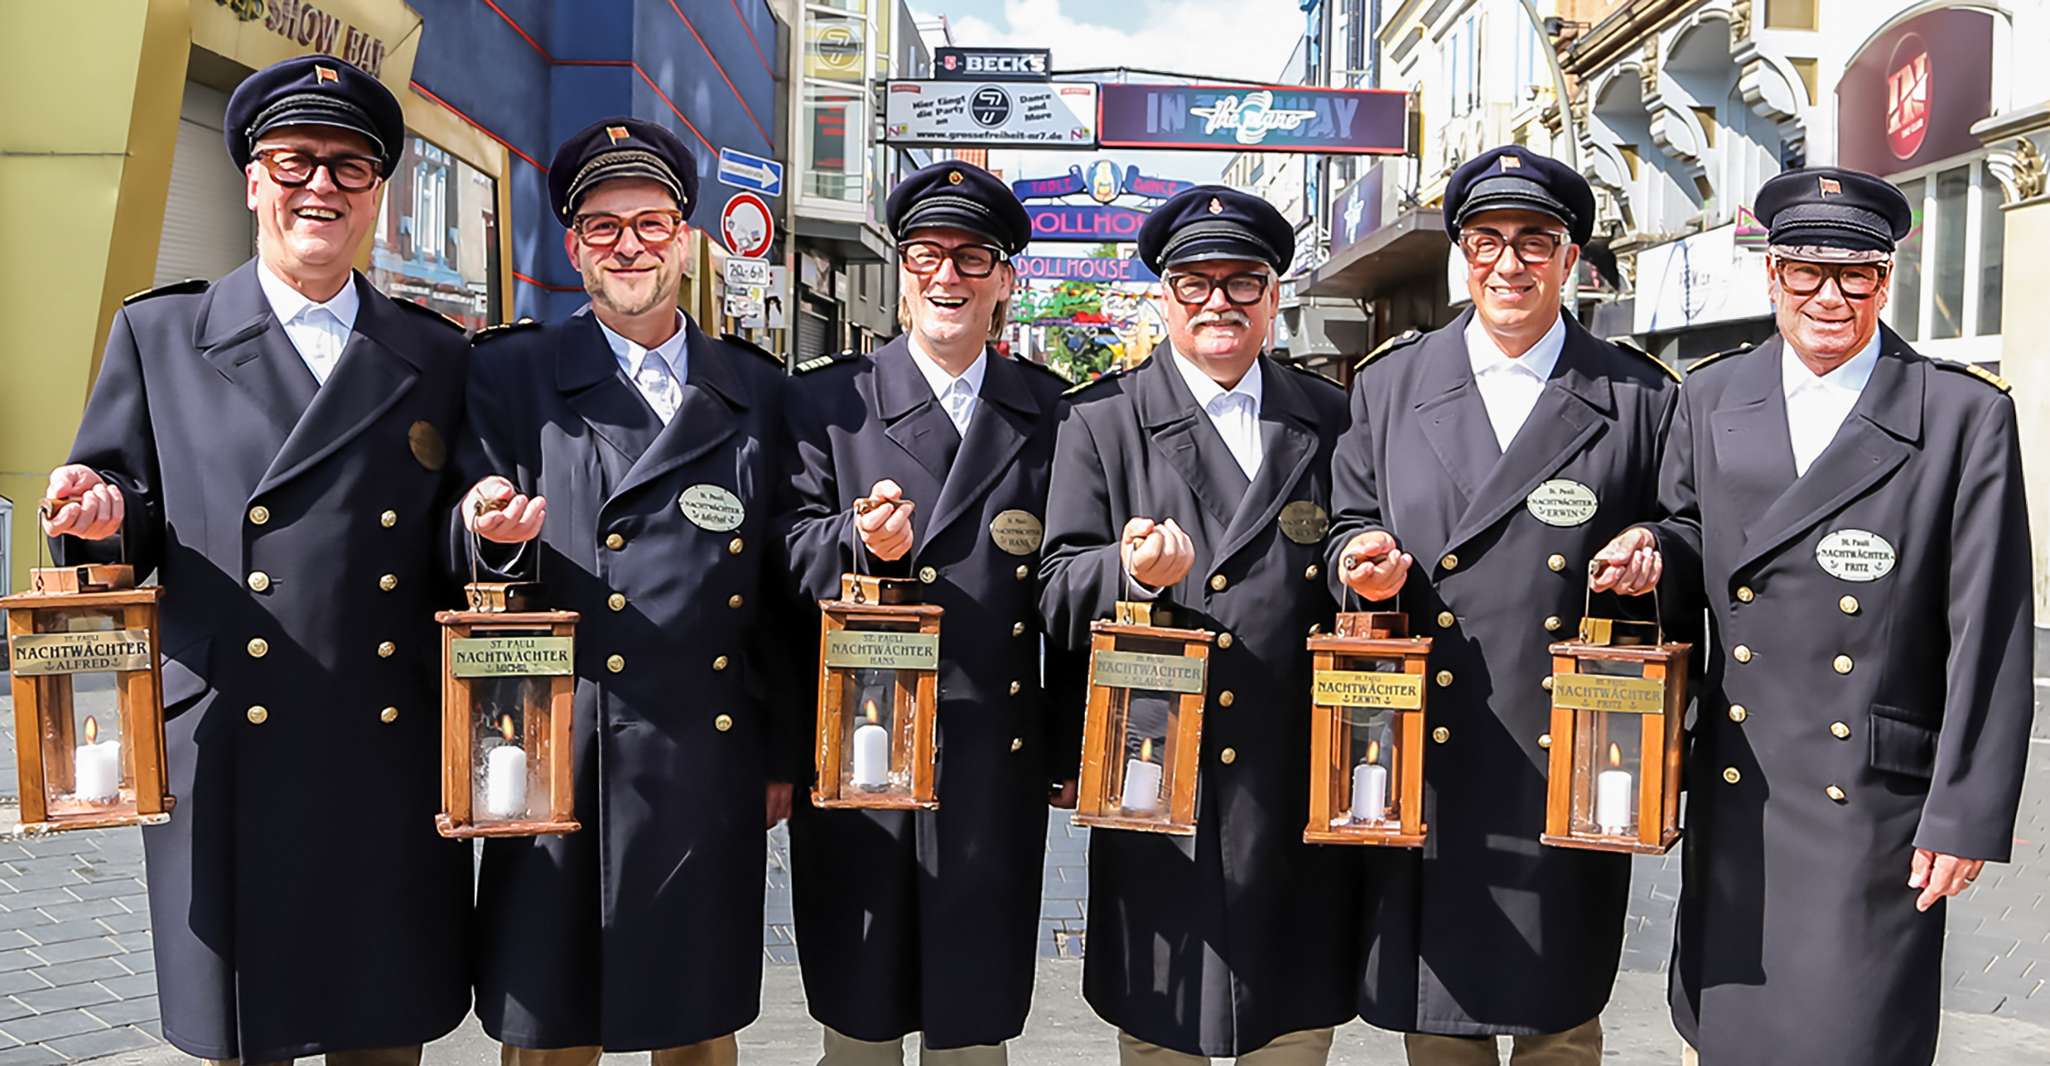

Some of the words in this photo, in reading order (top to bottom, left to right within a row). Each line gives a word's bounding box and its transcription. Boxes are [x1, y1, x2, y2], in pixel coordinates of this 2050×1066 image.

[265, 0, 340, 53] SHOW
[966, 56, 1046, 72] BECK'S
[1020, 94, 1051, 104] Dance
[936, 106, 964, 116] Party
[1028, 102, 1047, 111] and
[1025, 112, 1052, 121] More
[1147, 93, 1186, 135] IN
[1016, 257, 1131, 279] DOLLHOUSE
[1845, 563, 1868, 572] FRITZ
[507, 639, 535, 648] PAULI
[16, 641, 147, 660] NACHTWÄCHTER
[56, 658, 110, 670] ALFRED
[870, 656, 895, 665] HANS
